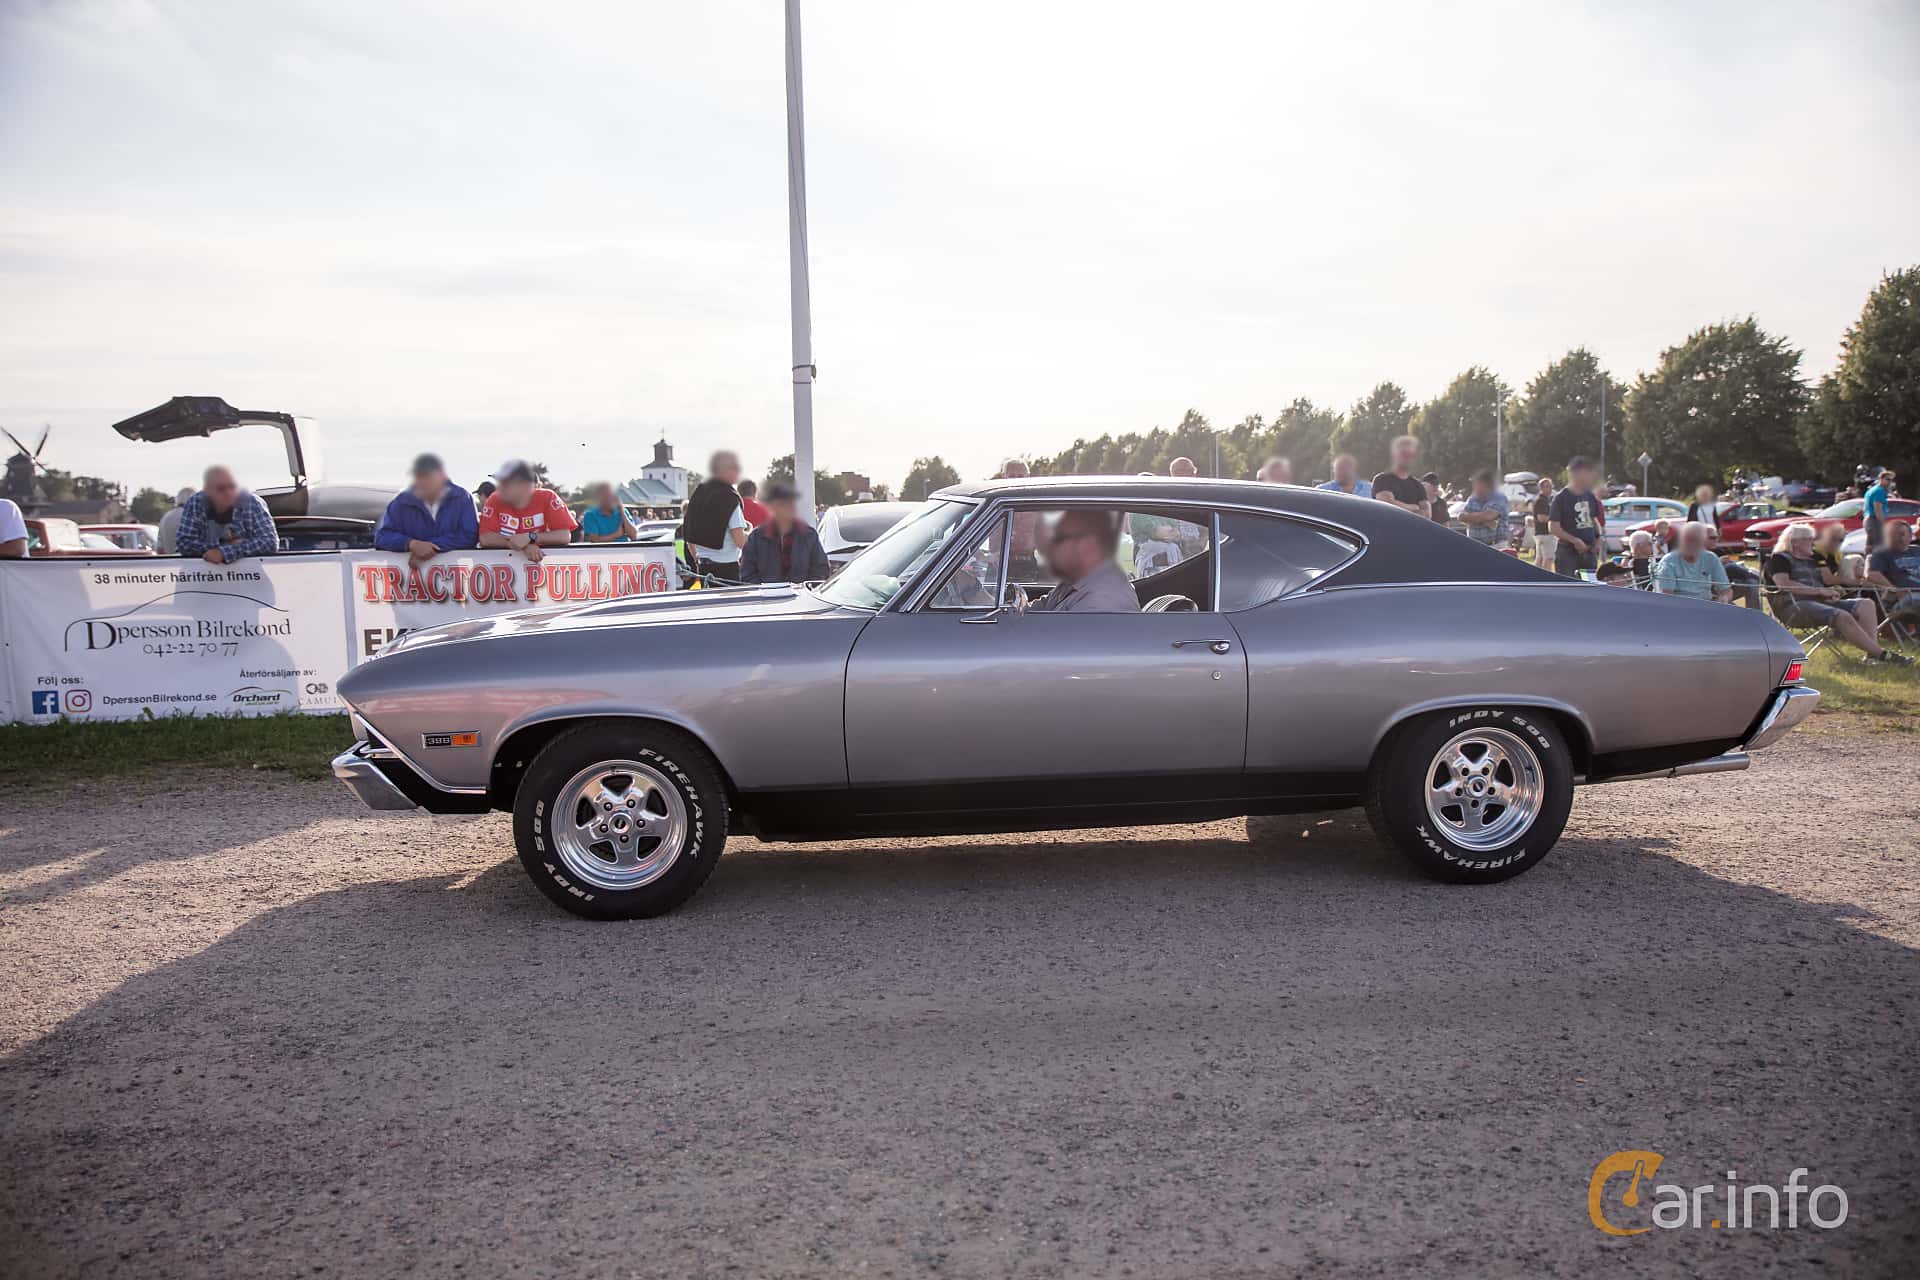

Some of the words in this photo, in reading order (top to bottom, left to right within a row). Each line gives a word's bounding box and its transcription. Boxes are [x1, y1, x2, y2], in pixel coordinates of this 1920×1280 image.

[94, 574, 110, 585] 38
[115, 573, 166, 585] minuter
[170, 571, 224, 584] härifrån
[227, 570, 261, 582] finns
[358, 564, 516, 603] TRACTOR
[523, 561, 668, 602] PULLING
[85, 620, 191, 650] Dpersson
[197, 618, 292, 638] Bilrekond
[199, 643, 217, 657] 70
[221, 642, 239, 657] 77
[37, 676, 58, 687] Följ
[61, 676, 84, 685] oss:
[239, 669, 301, 679] Återförsäljare
[102, 693, 217, 706] DperssonBilrekond.se
[233, 693, 281, 702] Orchard
[1449, 710, 1505, 729] INDY
[1511, 716, 1551, 749] 500
[638, 748, 704, 859] FIREHAWK
[1416, 824, 1527, 870] FIREHAWK
